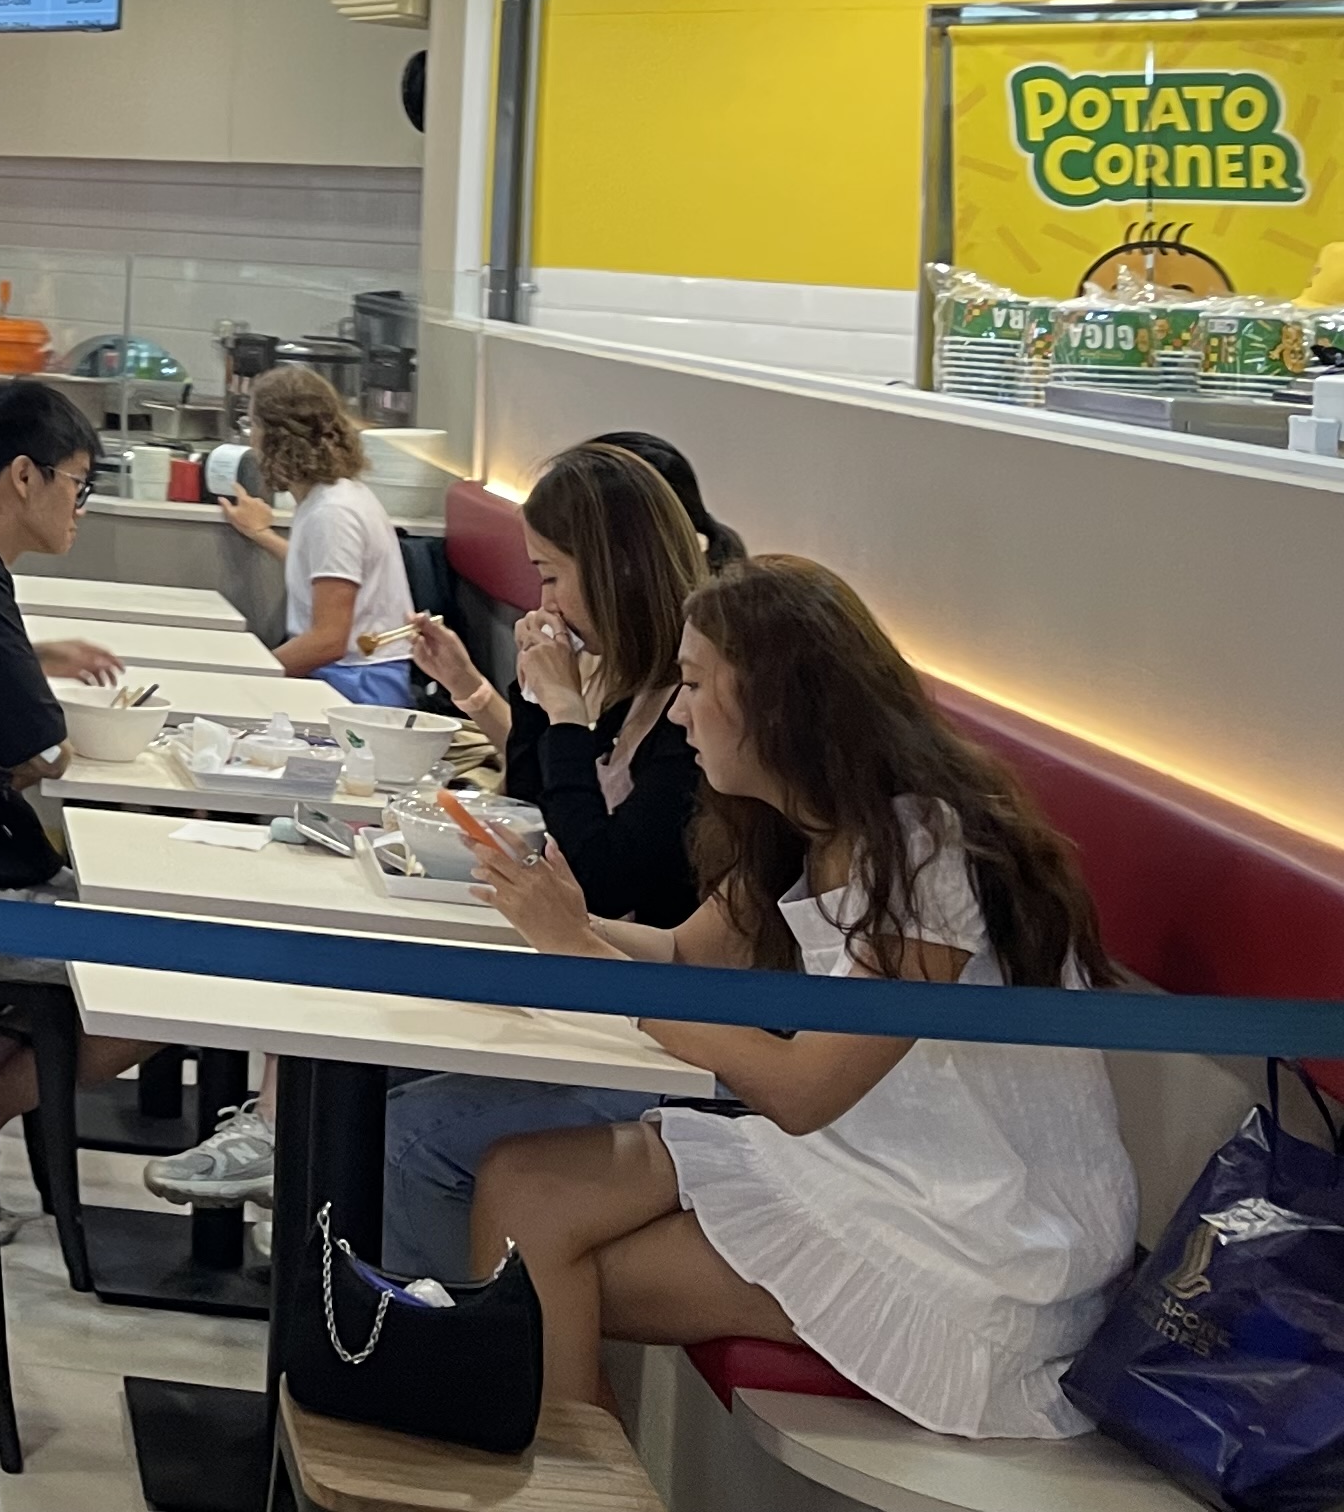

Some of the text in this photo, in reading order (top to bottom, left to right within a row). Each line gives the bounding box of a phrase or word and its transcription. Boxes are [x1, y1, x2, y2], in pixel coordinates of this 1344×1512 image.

[1022, 78, 1268, 142] POTATO
[1044, 135, 1288, 196] CORNER
[1068, 322, 1134, 350] GIGA
